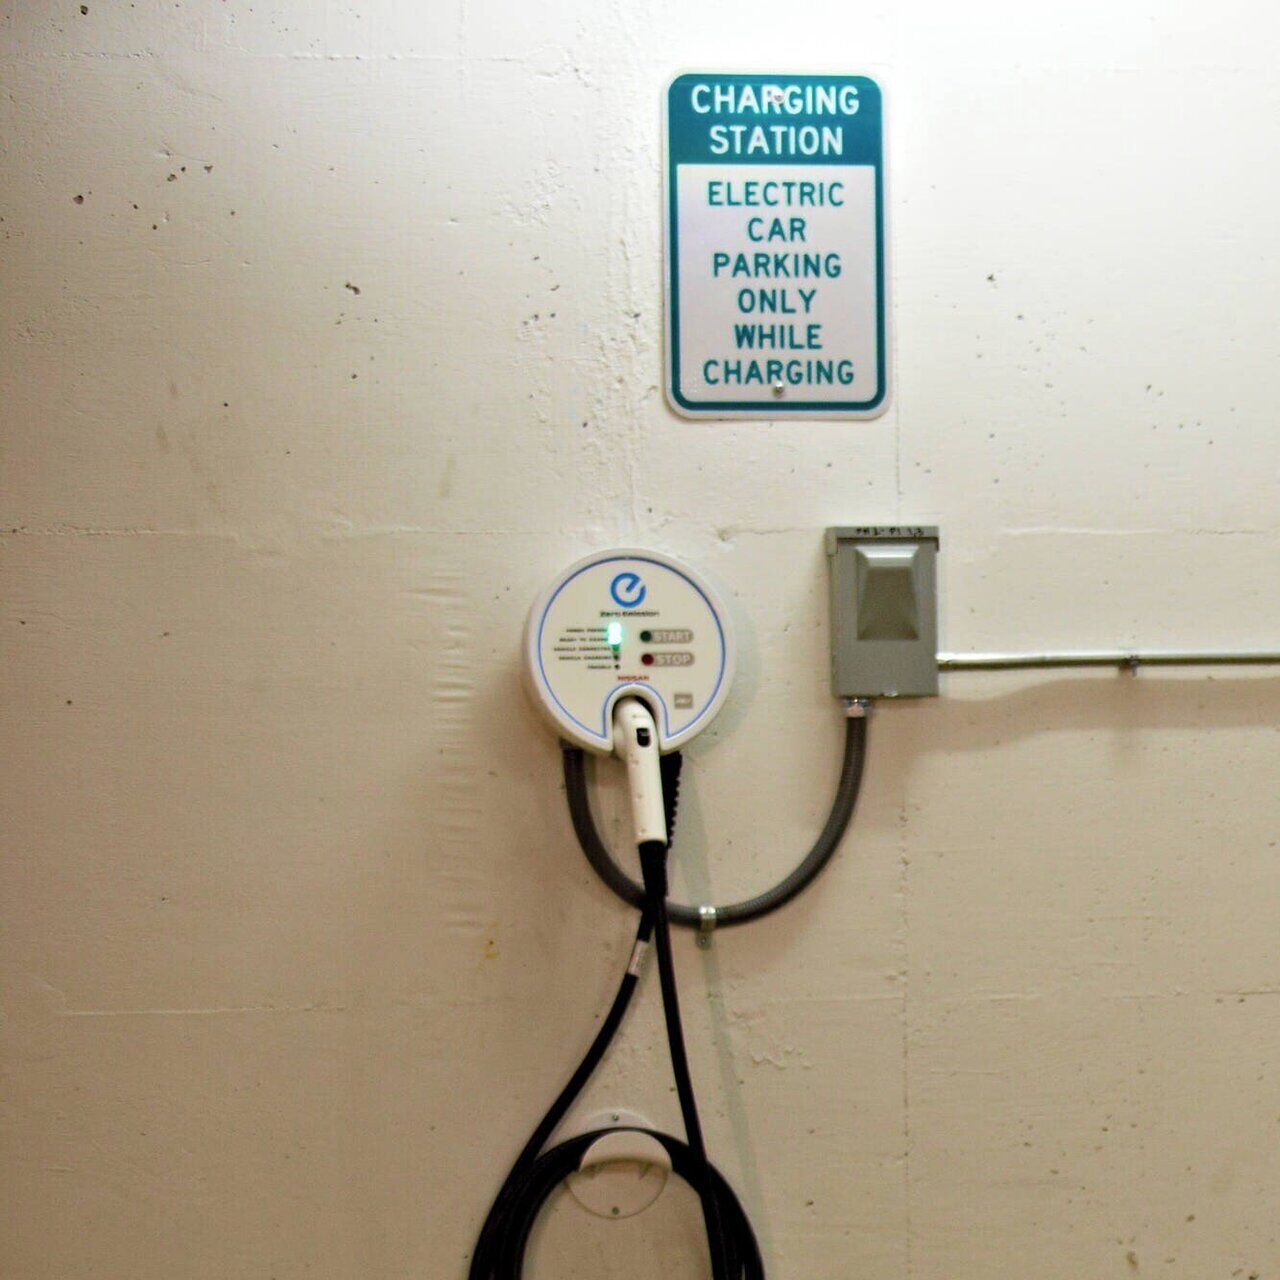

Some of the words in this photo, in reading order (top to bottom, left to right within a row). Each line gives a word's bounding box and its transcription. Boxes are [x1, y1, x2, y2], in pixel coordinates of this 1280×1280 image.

[691, 84, 860, 116] CHARGING
[709, 125, 843, 155] STATION
[708, 181, 844, 207] ELECTRIC
[747, 217, 806, 243] CAR
[713, 252, 842, 279] PARKING
[737, 288, 817, 314] ONLY
[734, 324, 822, 350] WHILE
[703, 359, 854, 385] CHARGING
